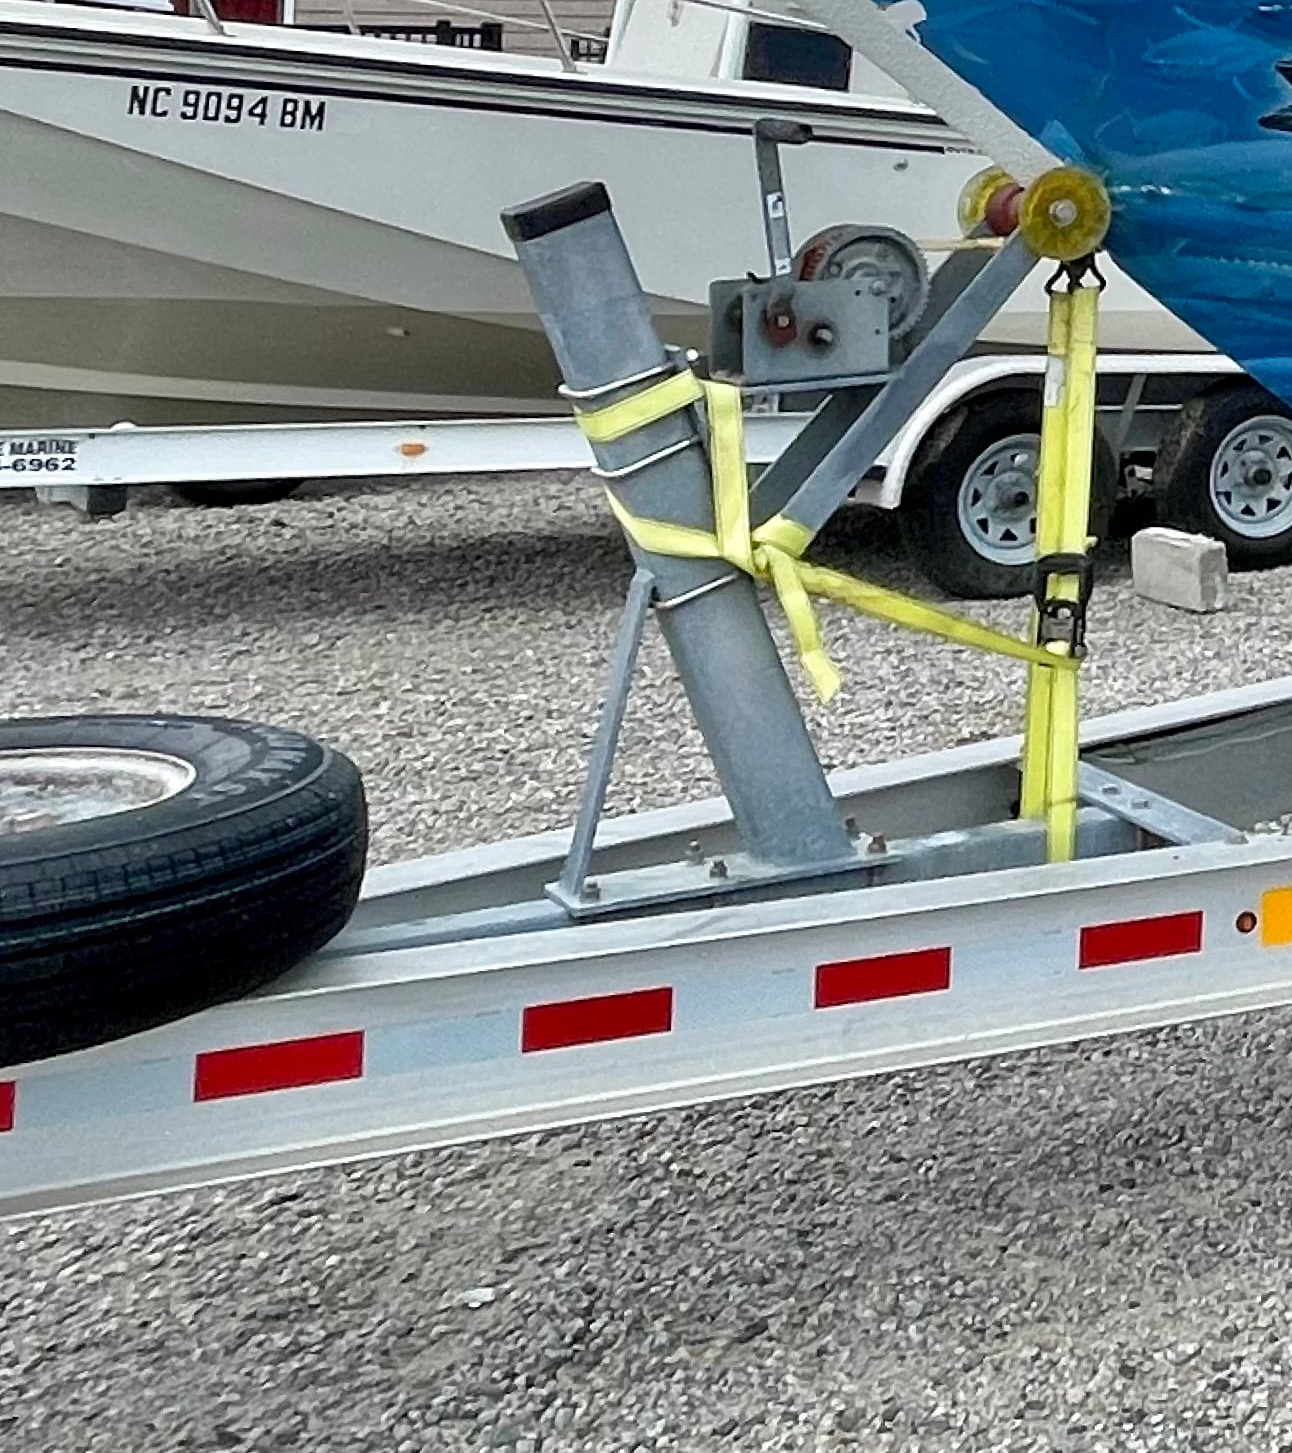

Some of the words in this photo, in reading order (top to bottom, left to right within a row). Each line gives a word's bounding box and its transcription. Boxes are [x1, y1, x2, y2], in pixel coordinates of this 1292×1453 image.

[127, 85, 173, 118] NC
[180, 89, 269, 127] 9094
[279, 98, 327, 132] BM
[0, 457, 77, 473] -6962
